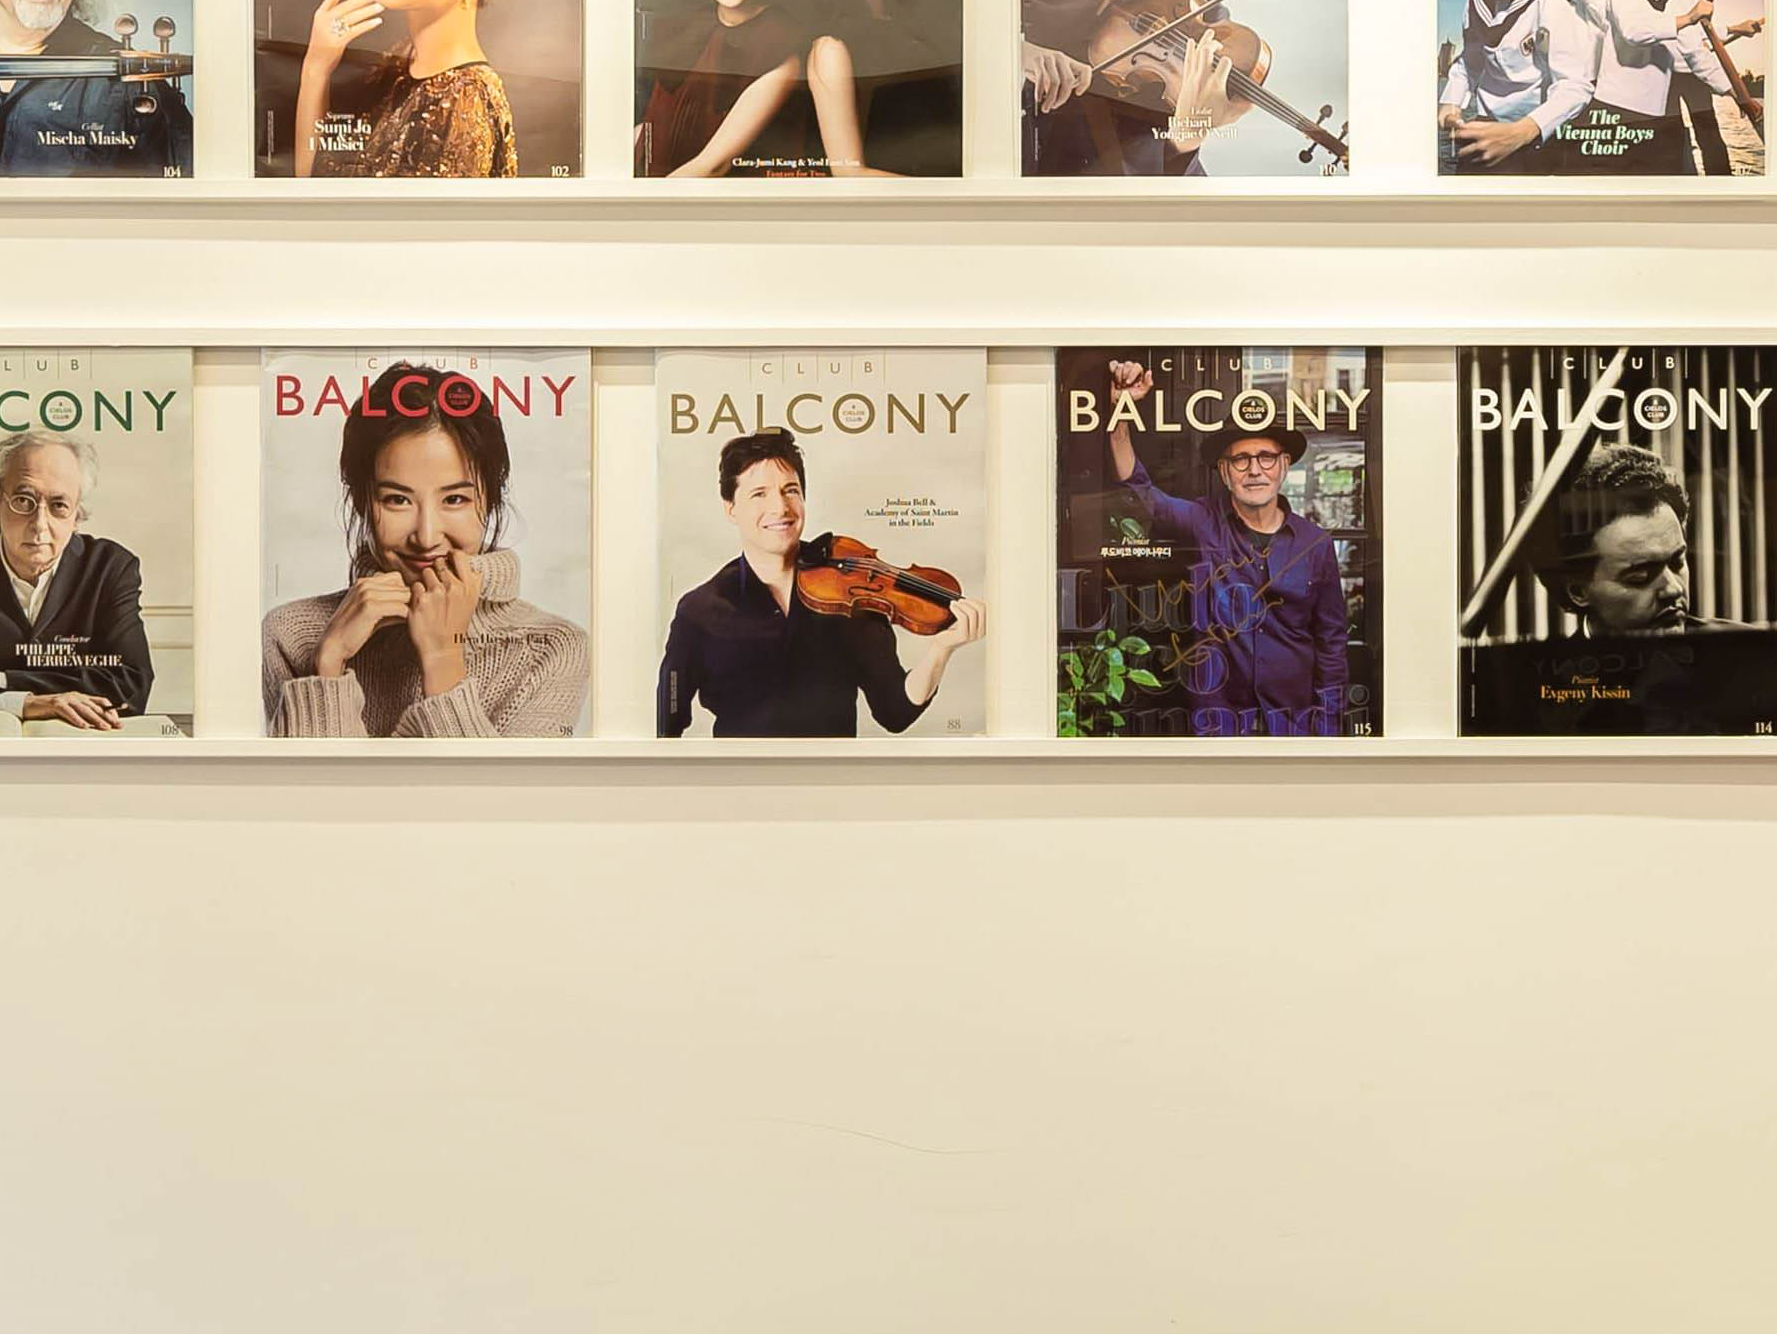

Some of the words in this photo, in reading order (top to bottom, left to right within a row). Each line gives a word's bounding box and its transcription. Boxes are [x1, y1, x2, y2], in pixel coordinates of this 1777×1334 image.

[1168, 115, 1212, 128] Richard
[1589, 109, 1621, 125] The
[314, 120, 352, 134] Sumi
[353, 119, 371, 134] Jo
[37, 130, 86, 145] Mischa
[89, 130, 138, 148] Maisky
[1555, 125, 1612, 140] Vienna
[1615, 125, 1655, 144] Boys
[318, 136, 364, 151] Musici
[1581, 140, 1629, 155] Choir
[163, 166, 181, 178] 104
[551, 165, 570, 177] 102
[368, 358, 479, 370] CLUB
[762, 362, 872, 374] CLUB
[1162, 359, 1273, 371] CLUB
[1563, 357, 1675, 370] CLUB
[276, 375, 576, 416] BALCONY
[671, 393, 971, 434] BALCONY
[1069, 389, 1371, 432] BALCONY
[1472, 388, 1773, 431] BALCONY
[885, 498, 911, 507] Joshua
[913, 498, 928, 506] Bell
[15, 643, 76, 655] PHILIPPE
[1540, 684, 1587, 703] Evgeny
[1591, 684, 1631, 699] Kissin
[161, 724, 179, 736] 108
[559, 725, 574, 736] 98
[1354, 723, 1372, 735] 115
[1755, 721, 1773, 733] 114
